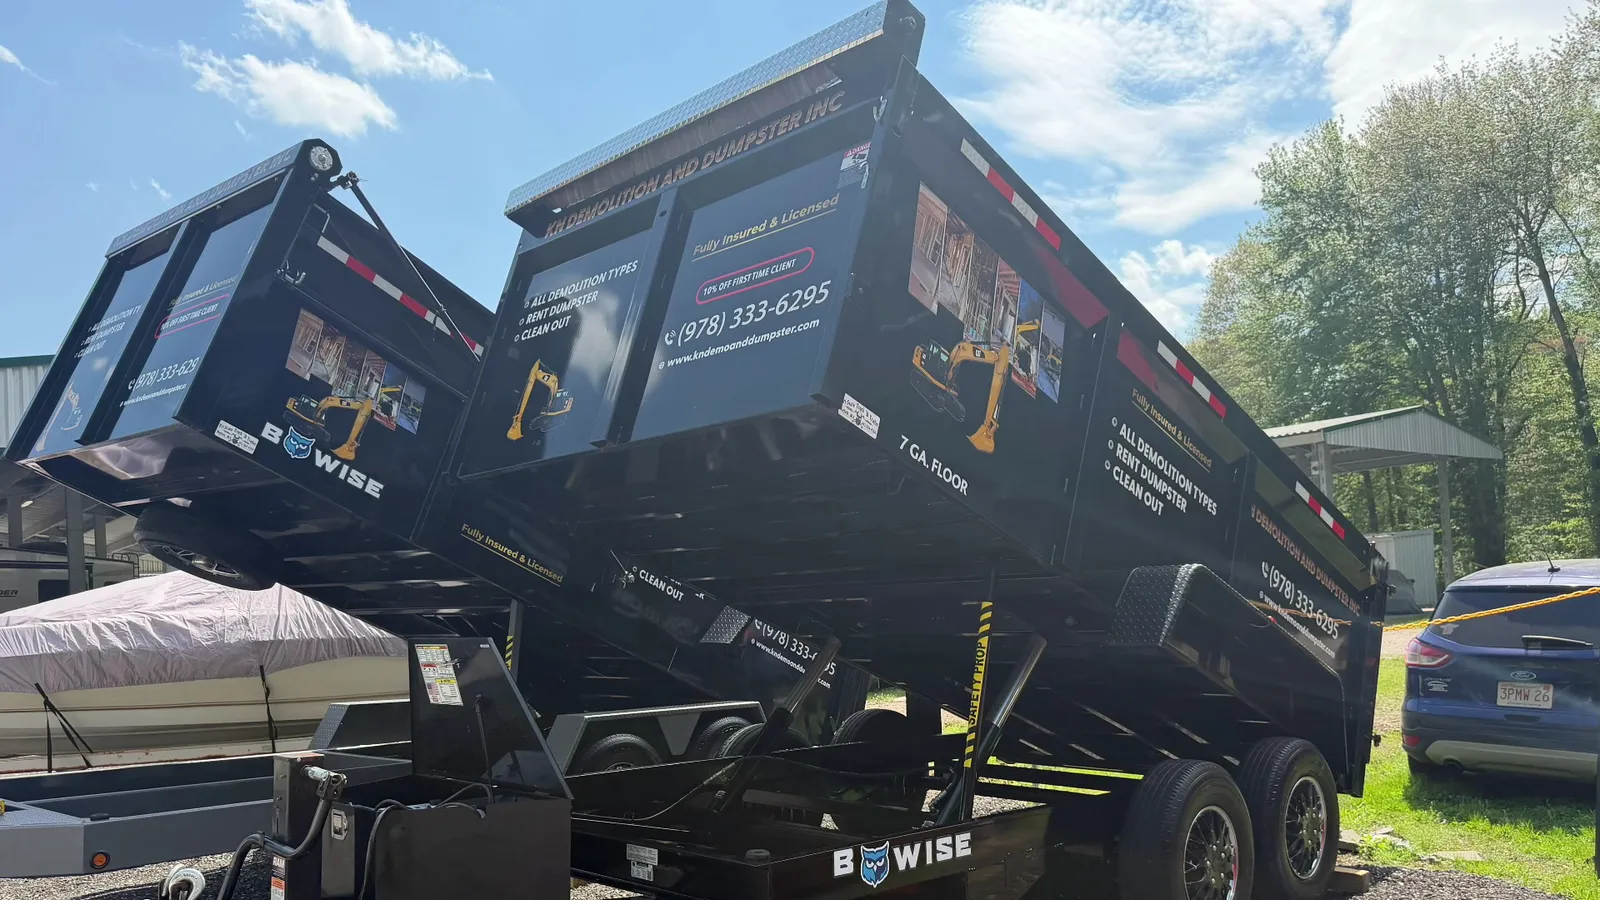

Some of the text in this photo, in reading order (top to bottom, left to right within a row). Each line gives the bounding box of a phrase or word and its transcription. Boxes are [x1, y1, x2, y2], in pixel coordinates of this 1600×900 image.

[566, 175, 660, 229] DEMOLITION
[661, 158, 699, 188] AND
[701, 109, 803, 170] DUMPSTER
[805, 91, 845, 124] INC
[693, 193, 840, 256] Fully Insured & Licensed
[530, 260, 639, 308] ALL DEMOLITION TYPES
[703, 258, 797, 296] 10% OFF FIRST TIME CLIENT
[521, 315, 572, 341] CLEAN OUT
[525, 290, 599, 325] RENT DUMPSTER
[678, 280, 832, 347] (978) 333-6295
[666, 318, 820, 368] www.kndemoanddumpster.com
[132, 357, 200, 391] (978) 333-629
[1132, 387, 1212, 468] Fully Insured & Licensed
[314, 448, 384, 499] WISE
[899, 434, 968, 497] 7 GA. FLOOR
[1112, 465, 1164, 516] CLEAN OUT
[1115, 442, 1188, 513] RENT DUMPSTER
[1119, 423, 1136, 447] ALL
[1137, 437, 1193, 495] DEMOLITION
[1193, 485, 1217, 516] TYPES
[461, 523, 564, 583] Fully Insured & Licensed
[1255, 507, 1301, 561] DEMOLITION
[1300, 553, 1316, 575] AND
[1315, 567, 1350, 607] DUMPSTER
[1349, 597, 1361, 617] INC
[639, 569, 666, 592] CLEAN
[666, 585, 684, 602] OUT
[1269, 565, 1339, 640] (978) 333-6295
[968, 642, 987, 725] SAFETY PROP
[1500, 687, 1550, 702] 3PMW 26
[892, 832, 972, 871] WISE
